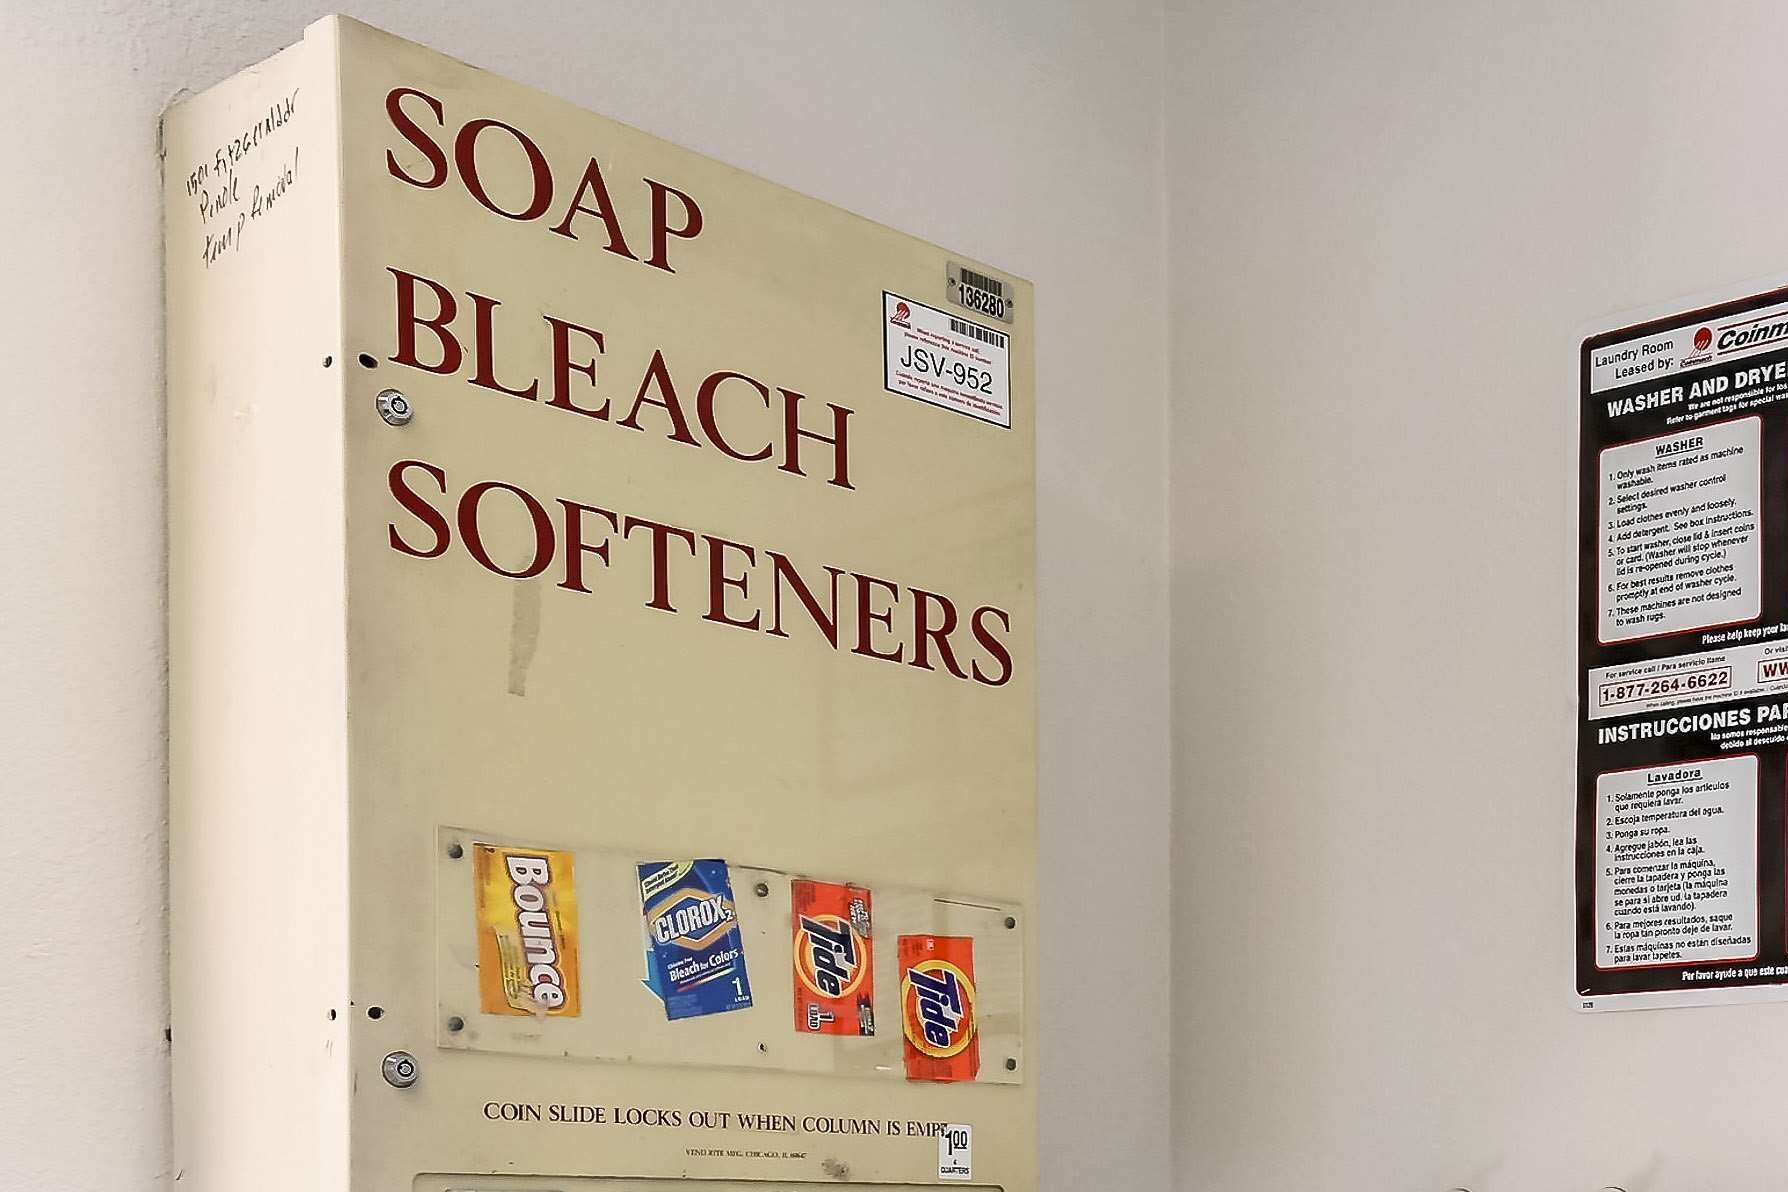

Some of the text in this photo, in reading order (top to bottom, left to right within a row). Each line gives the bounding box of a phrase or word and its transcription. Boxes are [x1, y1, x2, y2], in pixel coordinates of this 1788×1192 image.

[386, 87, 703, 273] SOAP
[959, 284, 1004, 317] 136280
[901, 346, 992, 394] JSV-952
[1595, 340, 1673, 367] Laundry Room
[1615, 357, 1673, 379] Leased by:
[386, 267, 855, 490] BLEACH
[1607, 386, 1683, 417] WASHER
[1688, 375, 1728, 399] AND
[1655, 436, 1703, 455] WASHER
[387, 460, 1013, 687] SOFTENERS
[1599, 670, 1731, 703] 1-877-264-6622
[1598, 708, 1751, 744] INSTRUCCIONES
[1647, 769, 1700, 782] Lavadora
[506, 856, 565, 1008] Bounce
[670, 961, 700, 982] Bleach
[709, 948, 739, 966] Colors
[800, 914, 857, 998] Tide
[907, 967, 964, 1048] Tide
[483, 1102, 541, 1121] COIN
[548, 1104, 606, 1123] SLIDE
[614, 1107, 681, 1126] LOCKS
[688, 1111, 730, 1128] OUT
[737, 1113, 795, 1131] WHEN
[802, 1116, 880, 1134] COLUMN
[887, 1120, 900, 1135] IS
